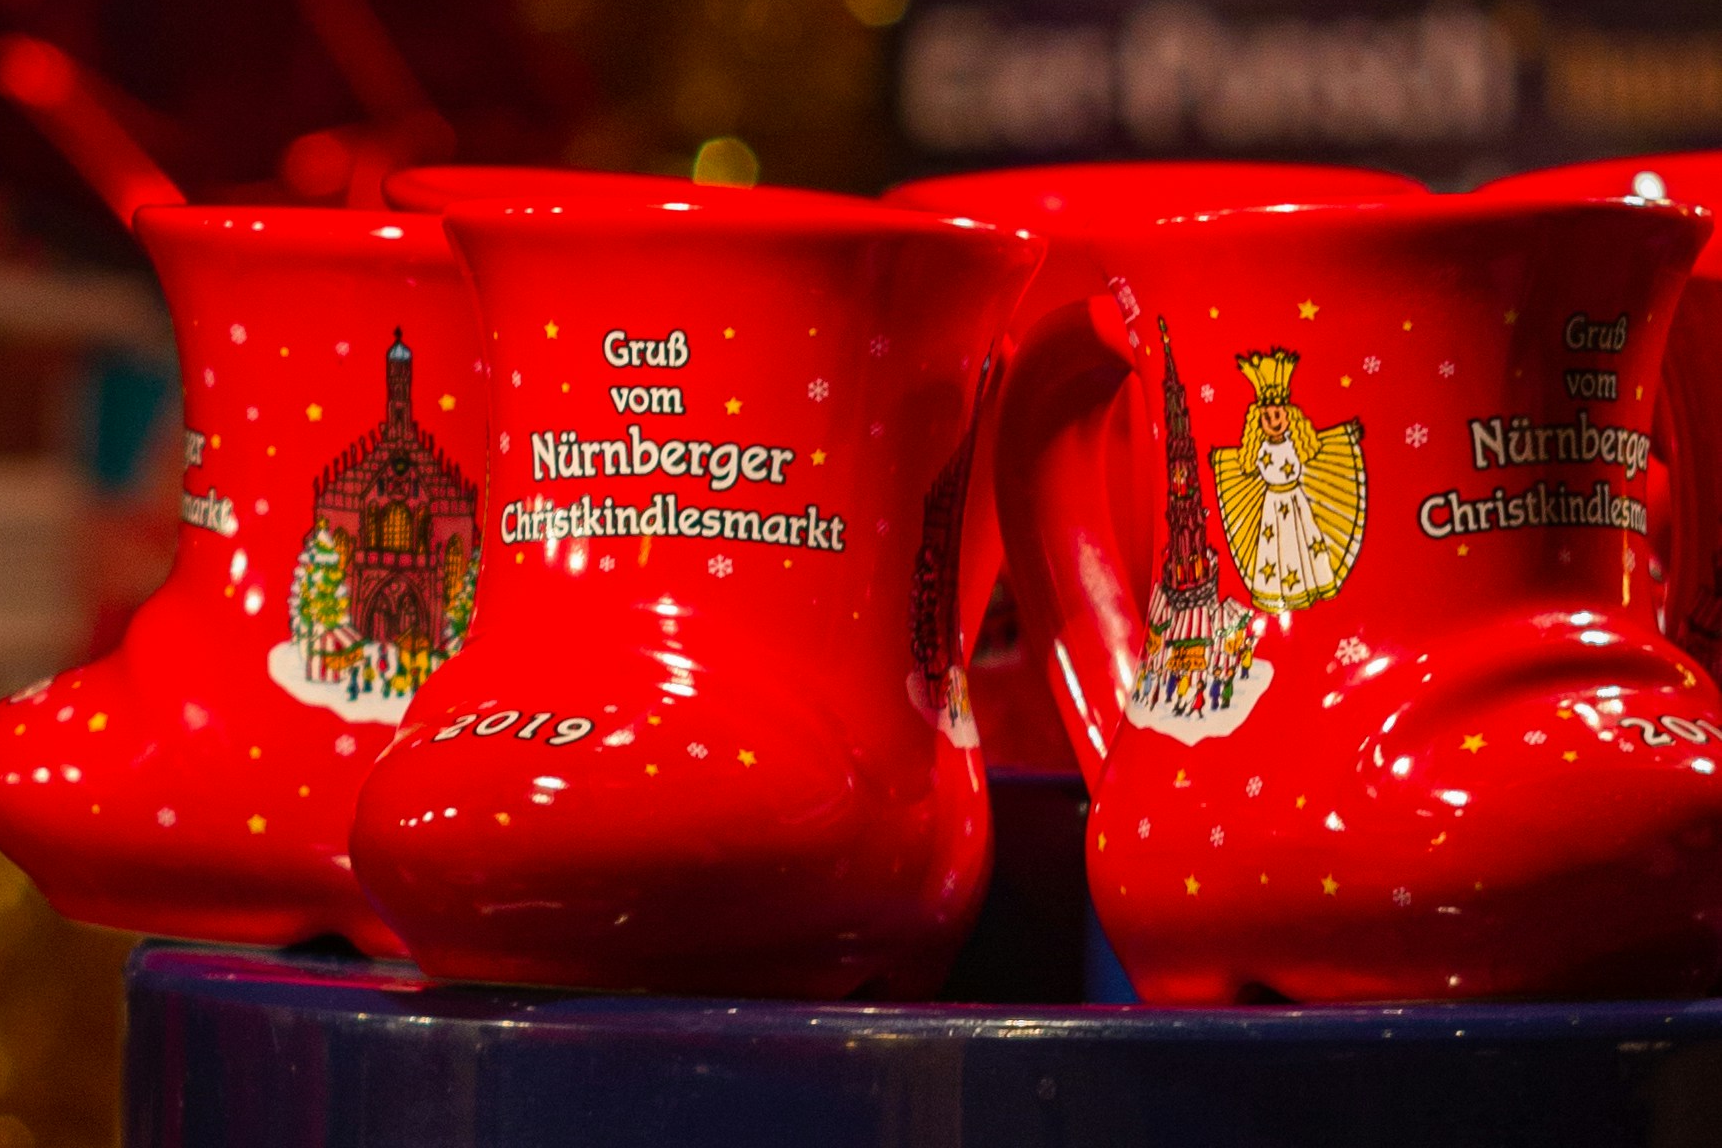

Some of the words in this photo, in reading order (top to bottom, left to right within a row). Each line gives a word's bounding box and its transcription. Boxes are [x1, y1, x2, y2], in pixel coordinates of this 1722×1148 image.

[603, 329, 689, 367] Gruß
[1565, 315, 1628, 351] Gruß
[610, 385, 685, 415] vom
[1565, 368, 1618, 401] vom
[531, 425, 795, 491] Nürnberger
[501, 494, 845, 551] Christkindlesmarkt
[432, 709, 594, 746] 2019
